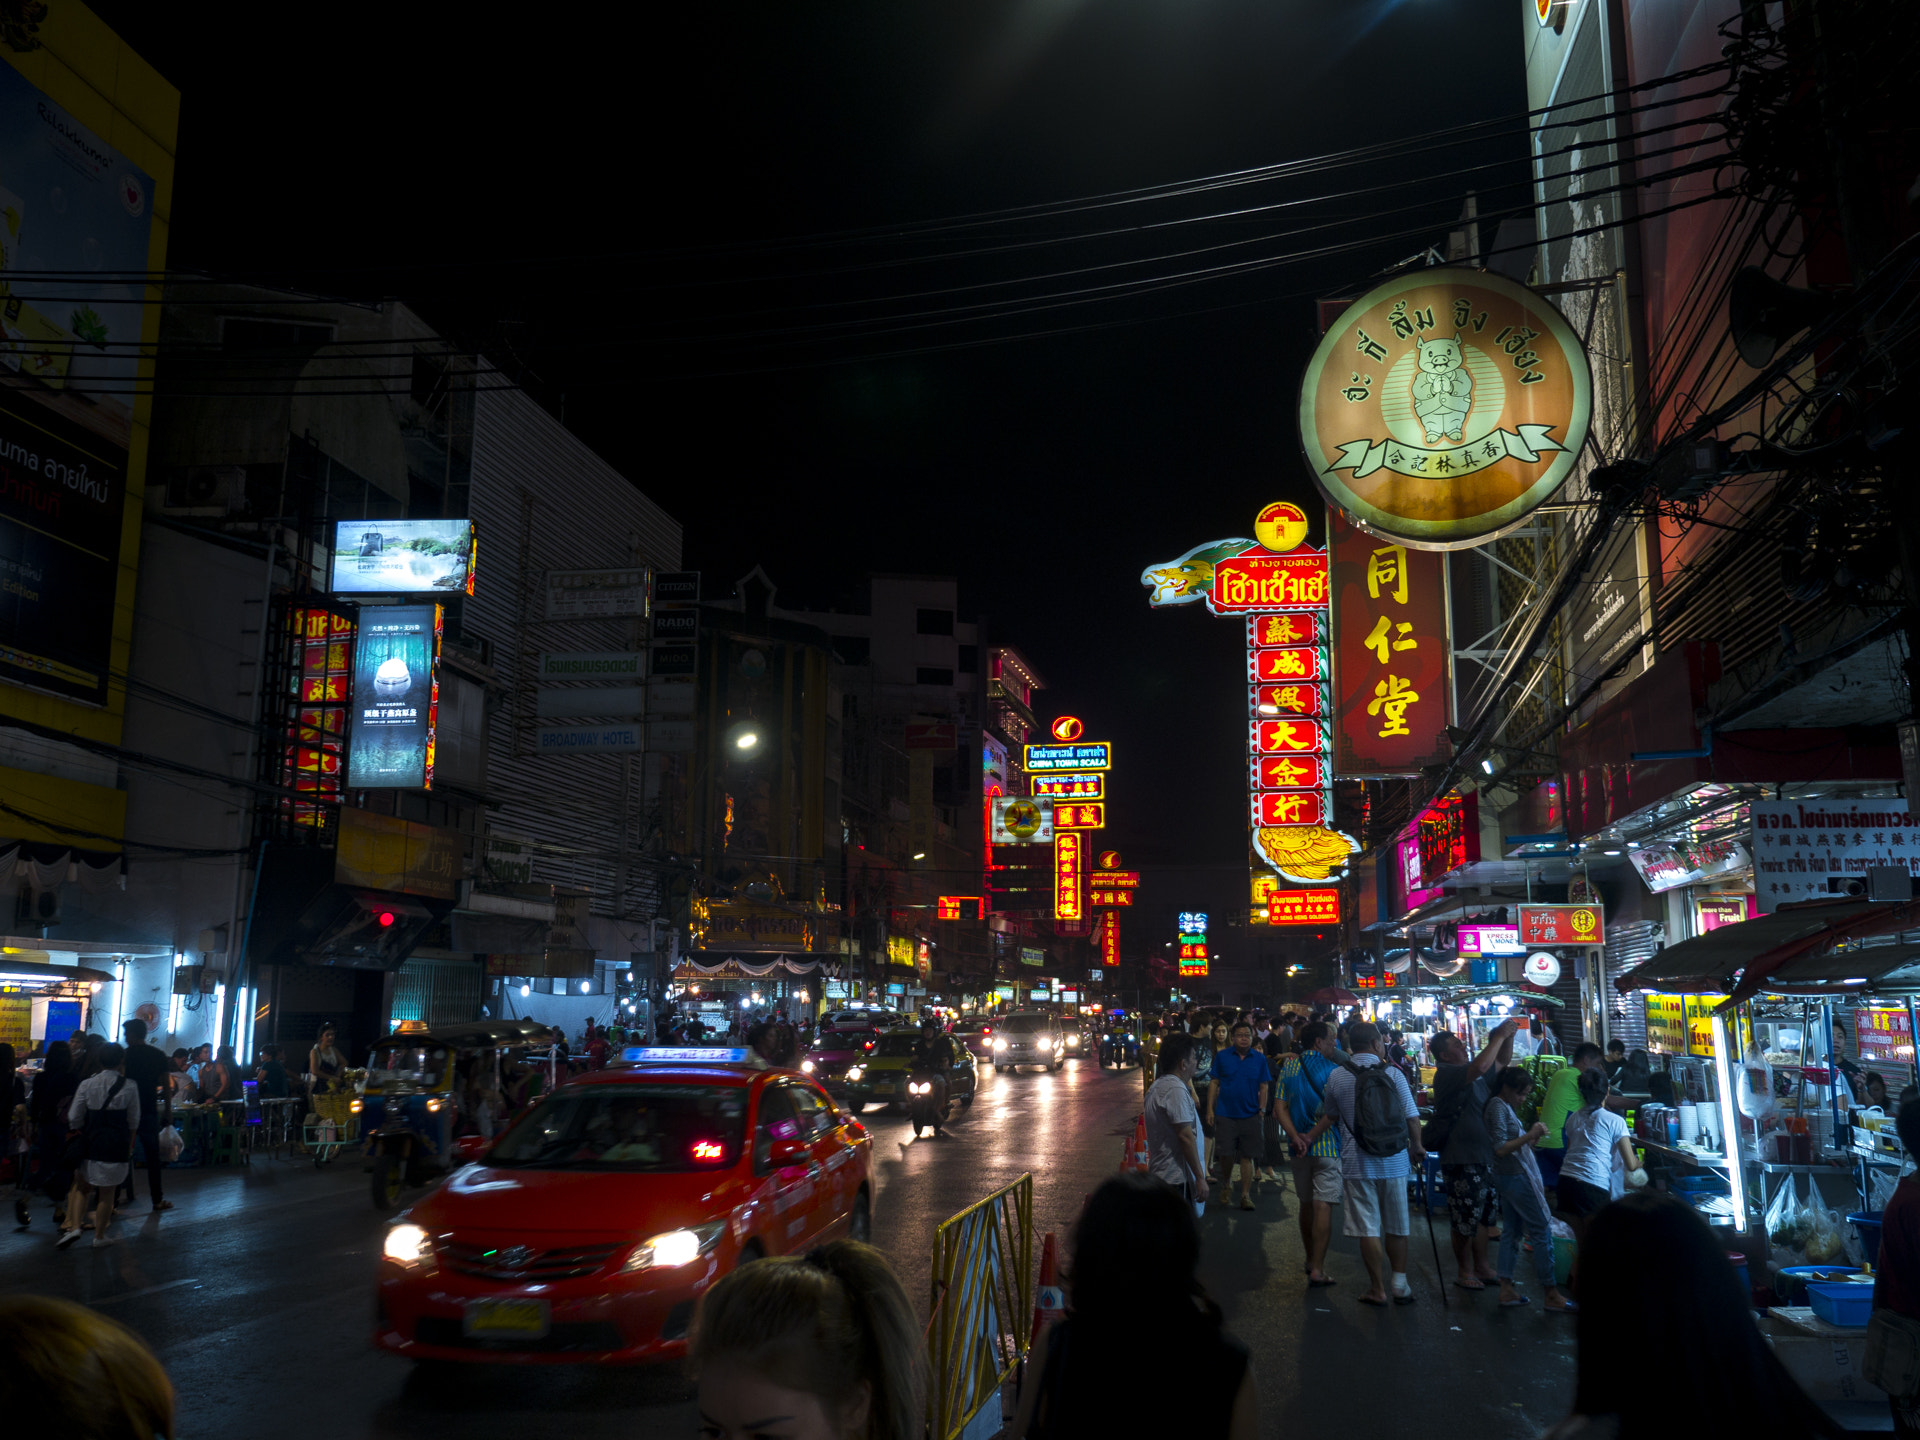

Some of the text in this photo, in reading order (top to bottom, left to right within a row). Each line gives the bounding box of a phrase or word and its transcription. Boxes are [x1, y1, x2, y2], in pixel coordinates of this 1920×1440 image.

[37, 102, 109, 168] Rilakkuma
[1387, 299, 1436, 339] ลิ้ม
[1388, 440, 1501, 473] 合記林真香
[44, 457, 109, 504] ลายใหม่
[2, 578, 39, 602] Edition
[657, 582, 696, 592] CITIZEN
[656, 617, 694, 627] RADO
[1363, 543, 1420, 738] 同仁堂
[659, 653, 689, 664] MIDO
[542, 731, 637, 748] BROADWAY HOTEL
[1028, 758, 1107, 769] CHINA TOWN SCALA
[1091, 891, 1129, 904] 中國城
[1719, 913, 1741, 923] Fruit
[1528, 925, 1558, 942] 中藥
